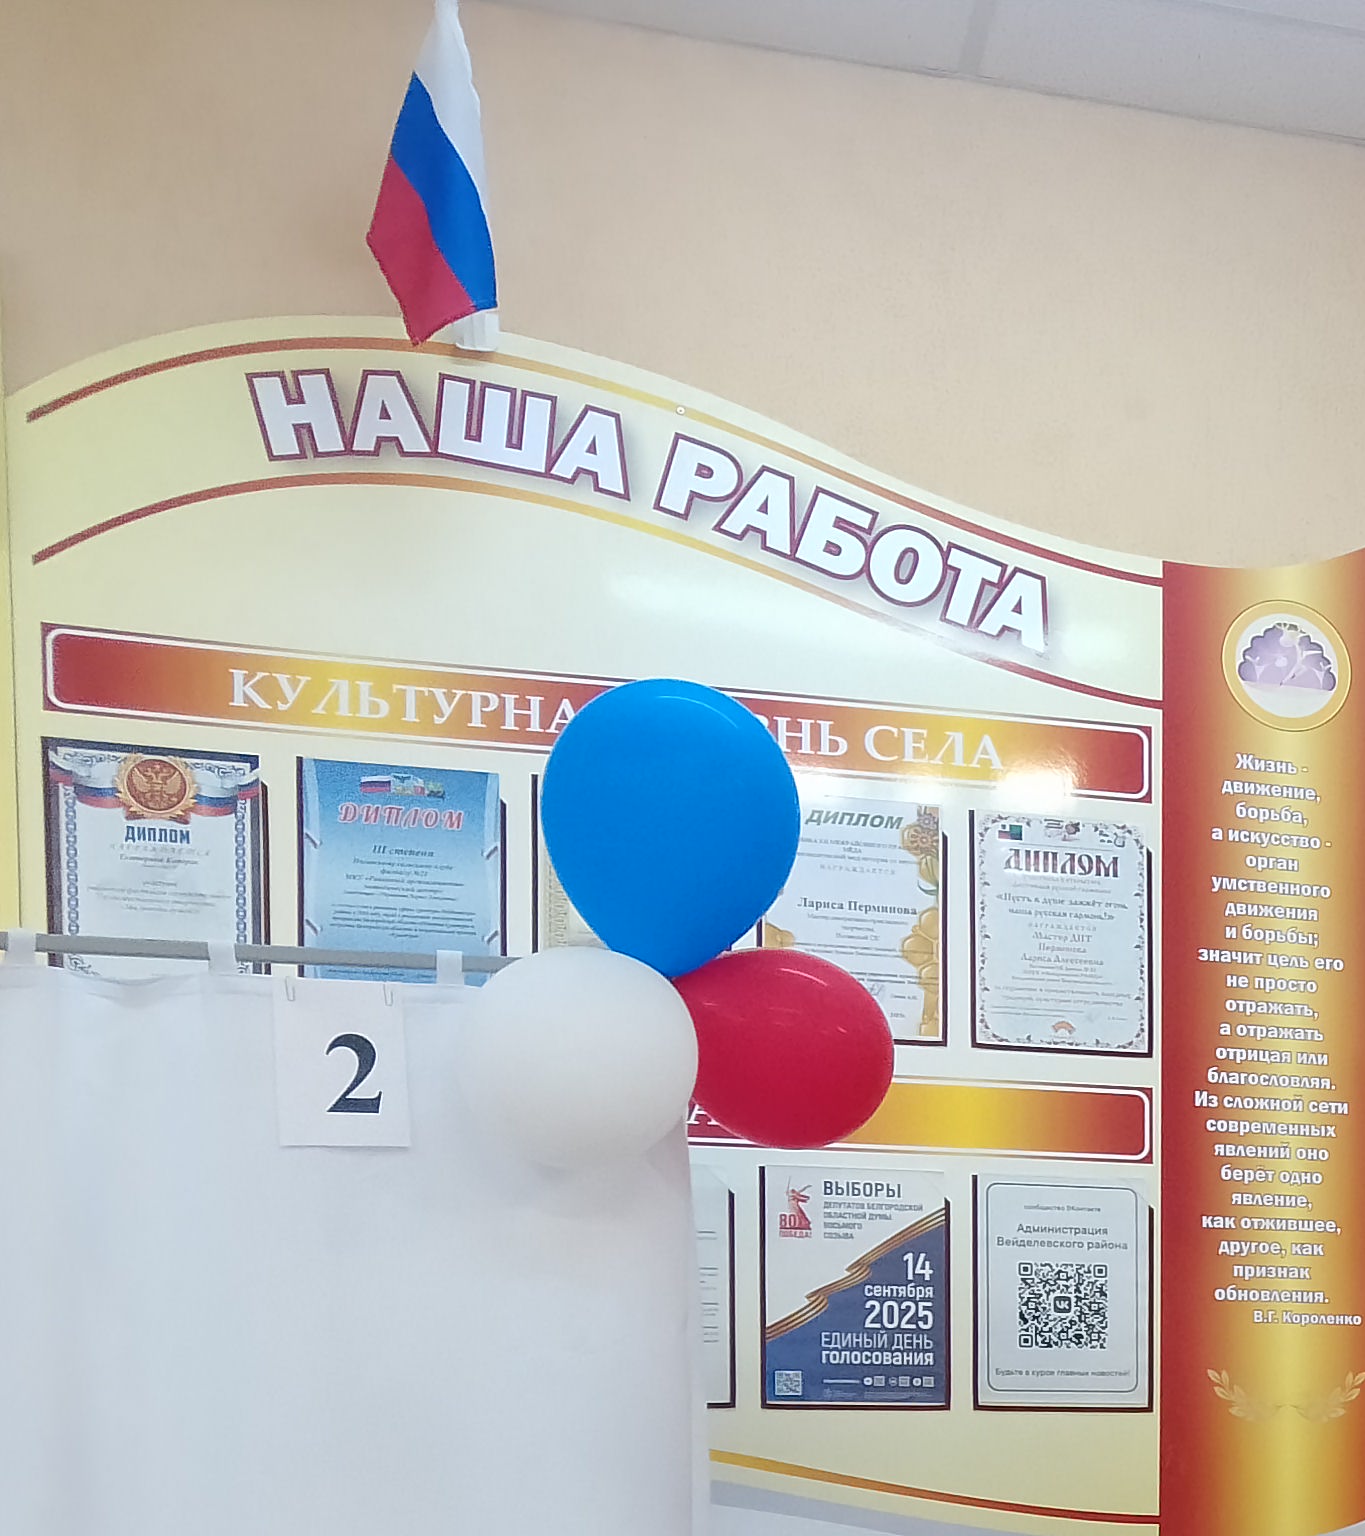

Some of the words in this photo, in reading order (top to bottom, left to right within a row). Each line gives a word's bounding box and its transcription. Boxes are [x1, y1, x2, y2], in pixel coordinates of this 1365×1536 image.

[245, 368, 631, 501] НАША
[653, 432, 1048, 656] РАБОТА
[754, 714, 848, 756] НЬ
[864, 725, 1003, 771] СЕЛА
[1235, 753, 1297, 774] Жизнь
[1222, 780, 1321, 802] движение,
[338, 802, 464, 830] ДИПЛОМ
[804, 808, 904, 830] ДИПЛОМ
[1235, 803, 1308, 825] борьба,
[124, 825, 191, 844] ДИПЛОМ
[1211, 828, 1223, 840] а
[1228, 829, 1321, 849] искусство
[1003, 848, 1119, 878] ДИПЛОМ
[1246, 855, 1299, 872] орган
[1211, 876, 1331, 898] умственного
[796, 897, 845, 911] Лариса
[847, 900, 918, 915] Перминова
[1224, 902, 1319, 921] движения
[1225, 926, 1237, 939] и
[1242, 924, 1319, 946] борьбы;
[1198, 948, 1262, 965] значит
[1267, 952, 1309, 969] цель
[1315, 956, 1344, 972] его
[1226, 974, 1249, 988] не
[1254, 976, 1318, 994] просто
[1225, 999, 1319, 1020] отражать,
[1219, 1023, 1231, 1035] а
[1235, 1024, 1325, 1042] отражать
[1215, 1046, 1292, 1065] отрицая
[1296, 1053, 1329, 1066] или
[325, 1033, 382, 1114] 2
[1207, 1067, 1337, 1090] благословляя.
[1194, 1090, 1218, 1108] Из
[1223, 1094, 1303, 1112] сложной
[1309, 1102, 1349, 1115] сети
[1206, 1118, 1337, 1138] современных
[1214, 1141, 1291, 1159] явлений
[1296, 1148, 1330, 1161] оно
[1221, 1164, 1275, 1185] берёт
[1280, 1171, 1323, 1186] одно
[823, 1180, 901, 1199] ВЫБОРЫ
[1232, 1192, 1313, 1211] явление,
[1017, 1223, 1108, 1236] Администрация
[1202, 1215, 1236, 1229] как
[1240, 1217, 1342, 1235] отжившее,
[996, 1236, 1085, 1249] Вейделевского
[1087, 1239, 1128, 1251] района
[1218, 1240, 1287, 1258] другое,
[1291, 1242, 1324, 1256] как
[903, 1252, 934, 1281] 14
[1233, 1264, 1311, 1281] признак
[864, 1284, 934, 1299] сентября
[1214, 1285, 1330, 1303] обновления.
[864, 1301, 934, 1330] 2025
[1253, 1310, 1278, 1324] В.Г.
[1282, 1311, 1362, 1327] Короленко
[820, 1330, 889, 1350] ЕДИНЫЙ
[891, 1333, 934, 1351] ДЕНЬ
[821, 1351, 935, 1366] голосования
